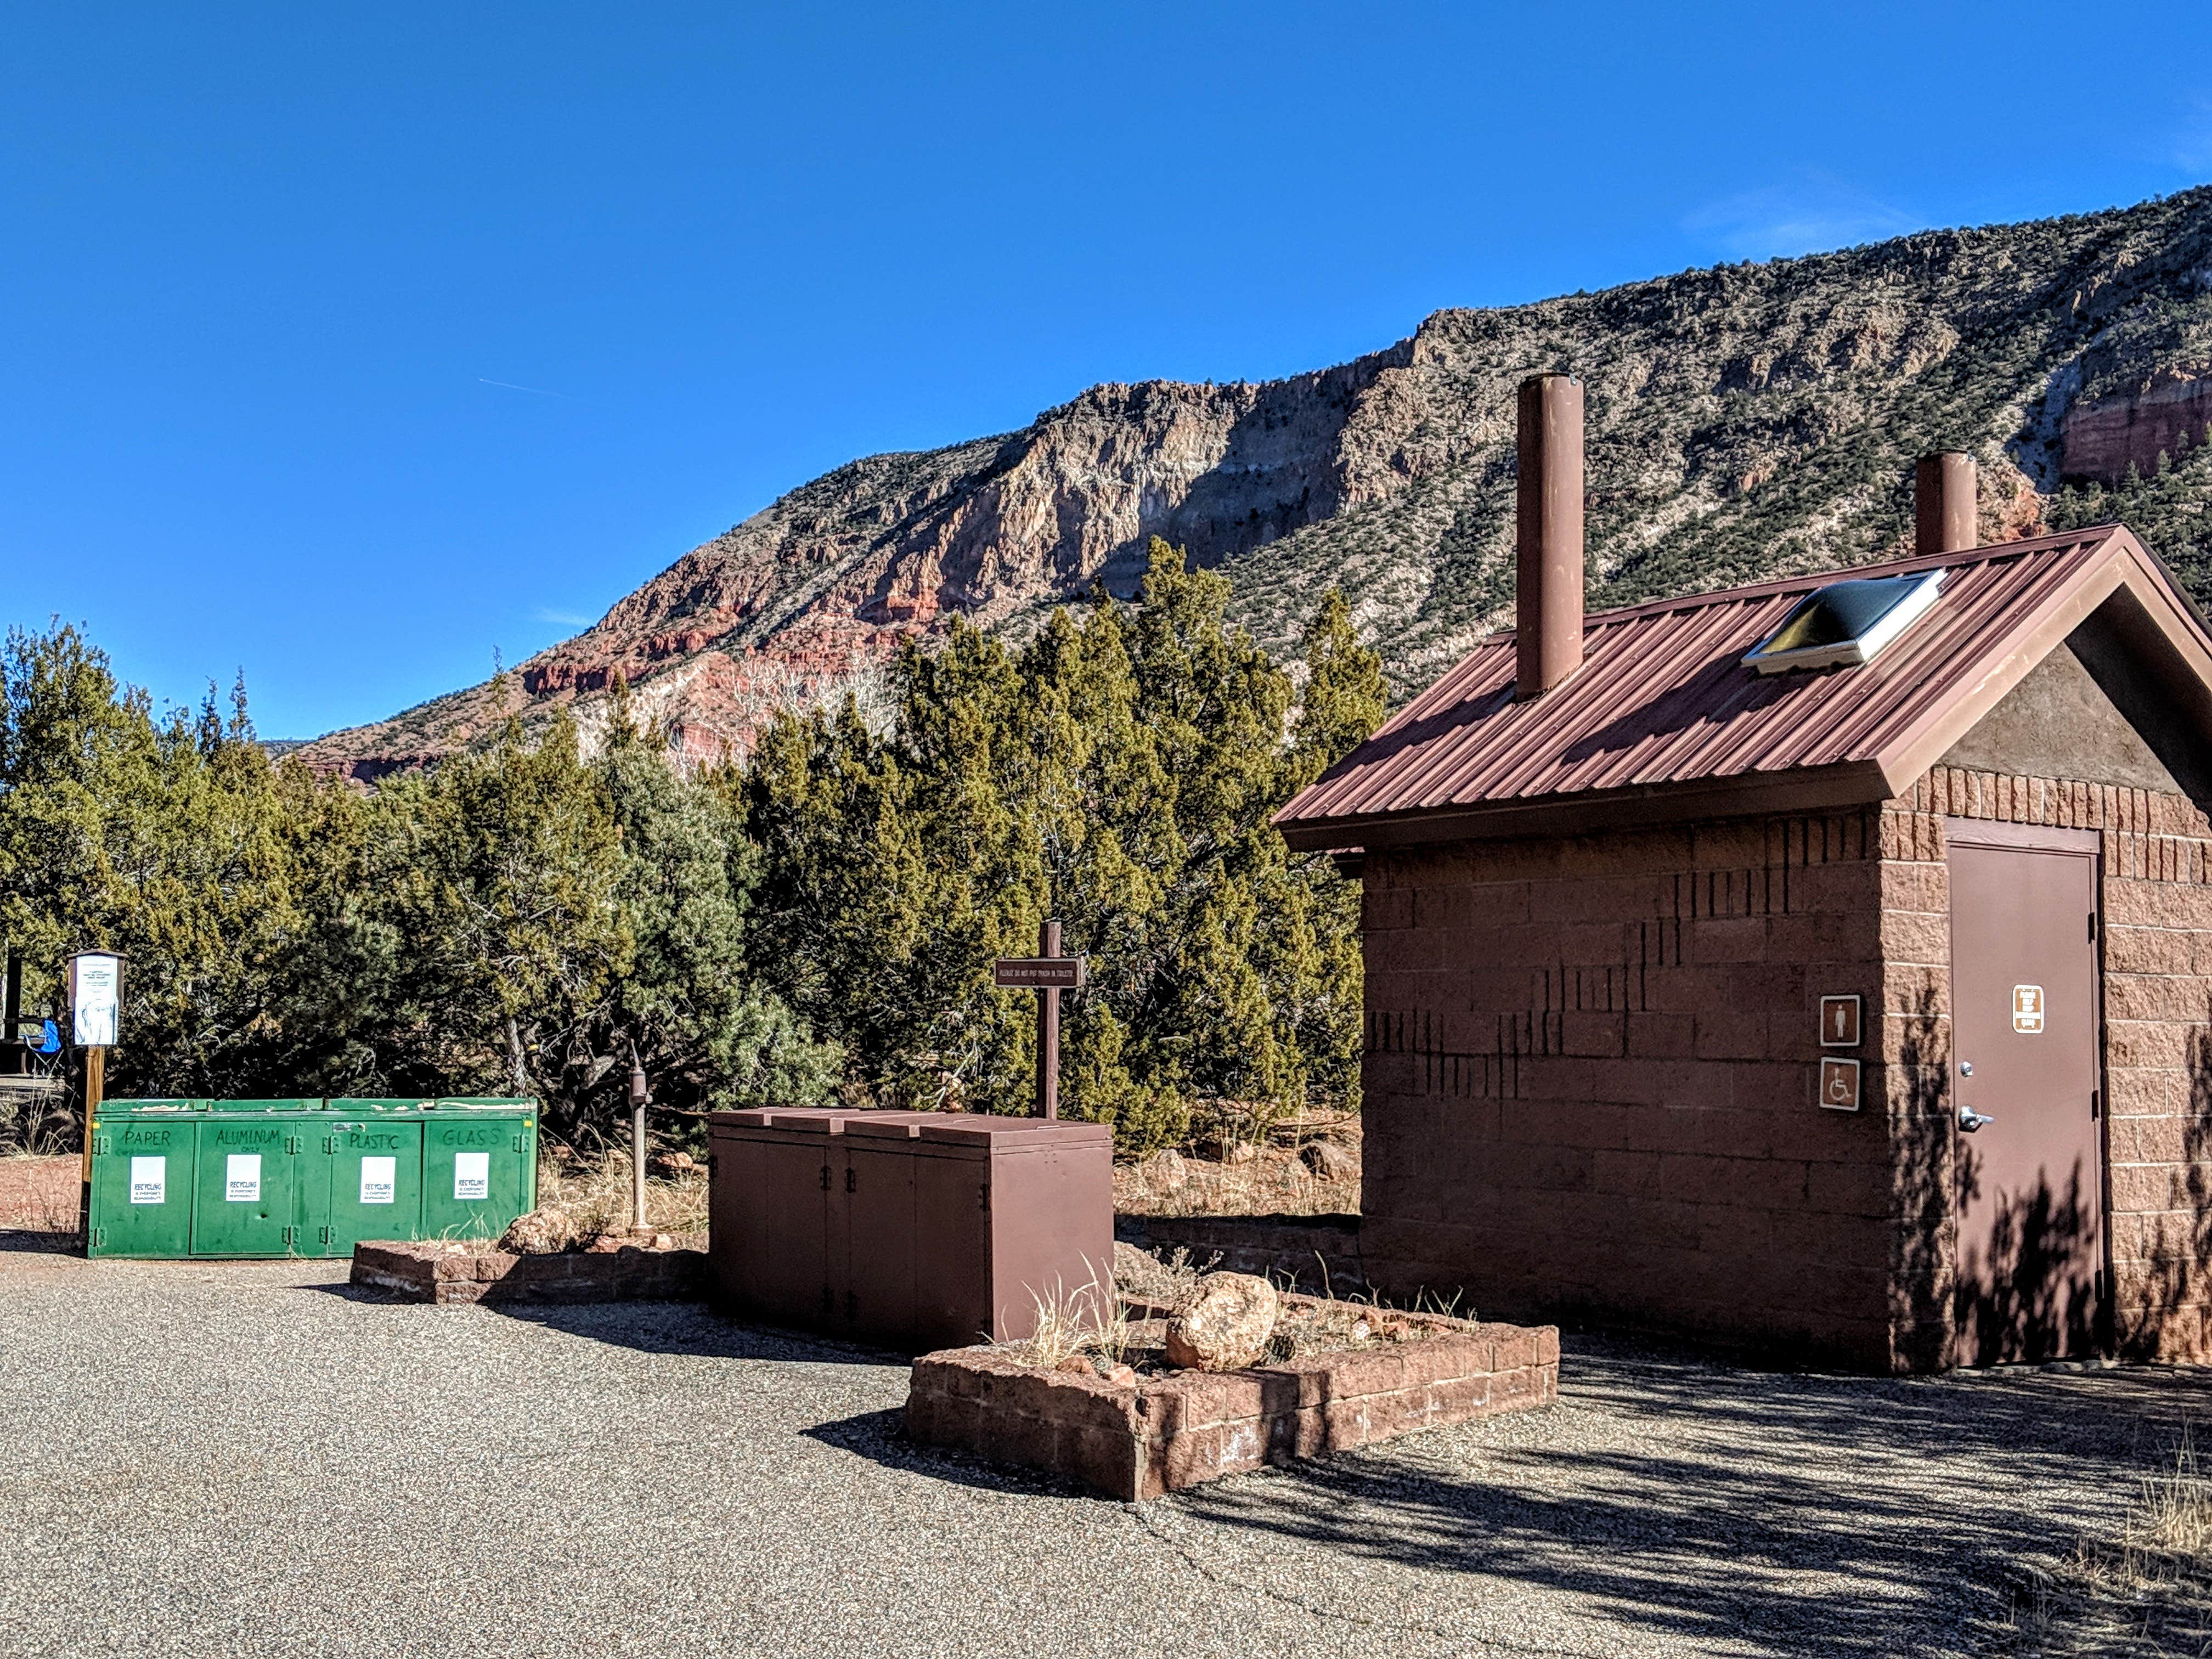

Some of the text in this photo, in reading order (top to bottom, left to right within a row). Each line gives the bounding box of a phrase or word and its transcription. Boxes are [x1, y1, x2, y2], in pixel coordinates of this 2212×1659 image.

[125, 1130, 171, 1146] PAPER
[216, 1129, 280, 1146] ALUMINUM
[349, 1132, 399, 1149] PLASTIC
[443, 1128, 501, 1146] GLASS
